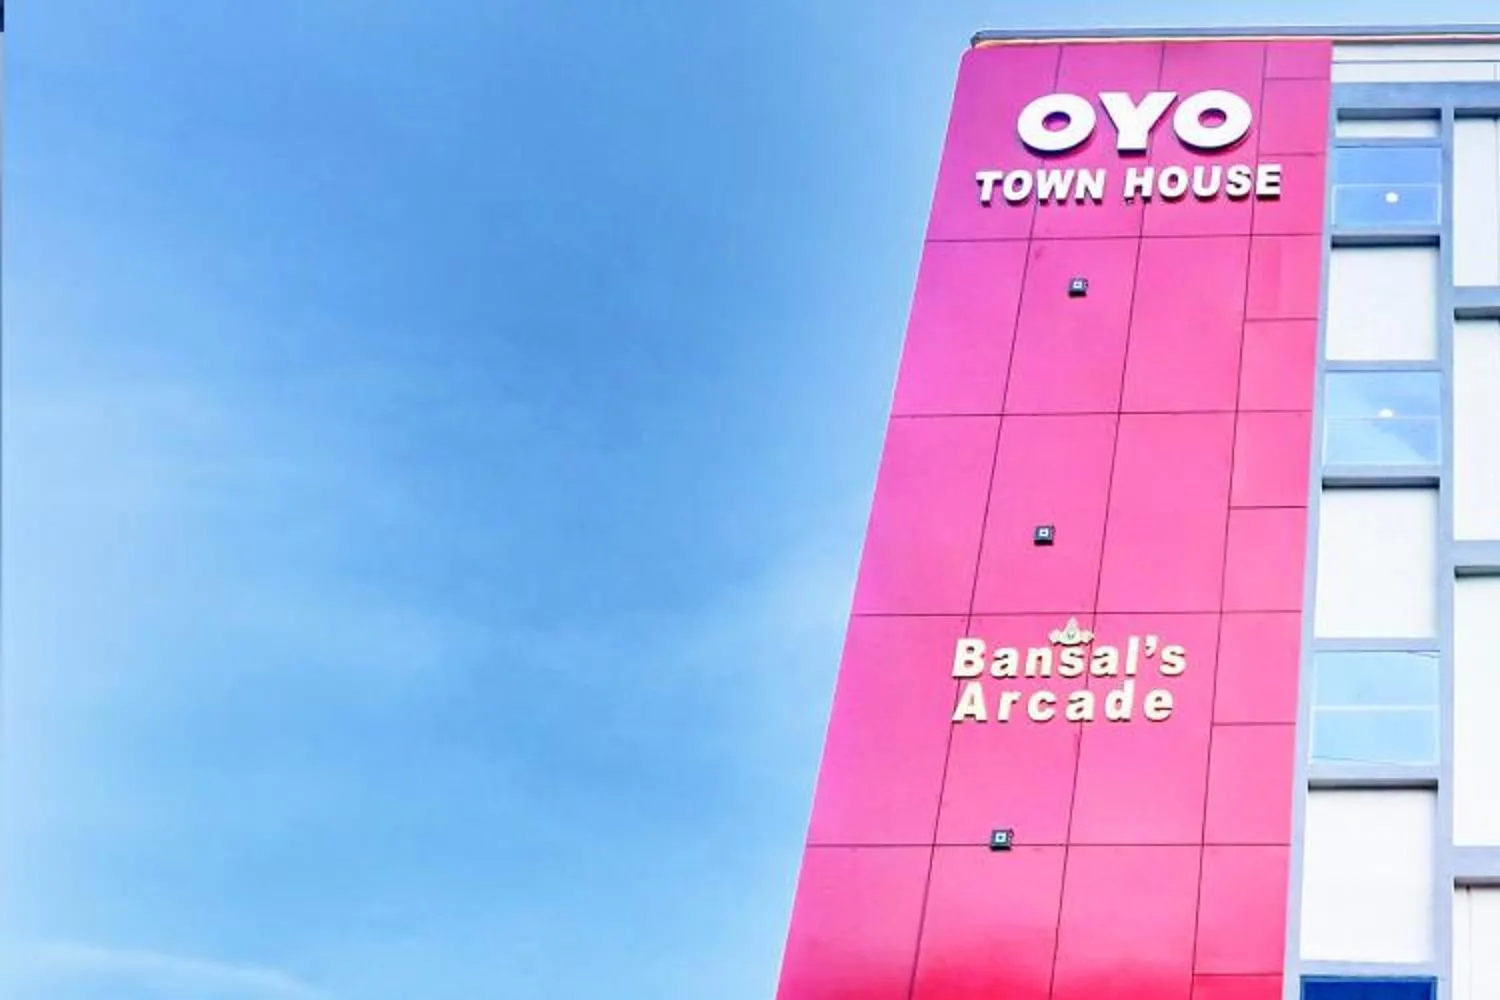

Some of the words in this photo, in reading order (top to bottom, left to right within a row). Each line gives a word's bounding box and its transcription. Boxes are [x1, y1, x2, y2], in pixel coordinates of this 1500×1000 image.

[1016, 89, 1253, 156] OYO
[975, 168, 1106, 206] TOWN
[1122, 164, 1282, 203] HOUSE
[952, 634, 1188, 678] Bansal's
[952, 679, 1175, 722] Arcade
